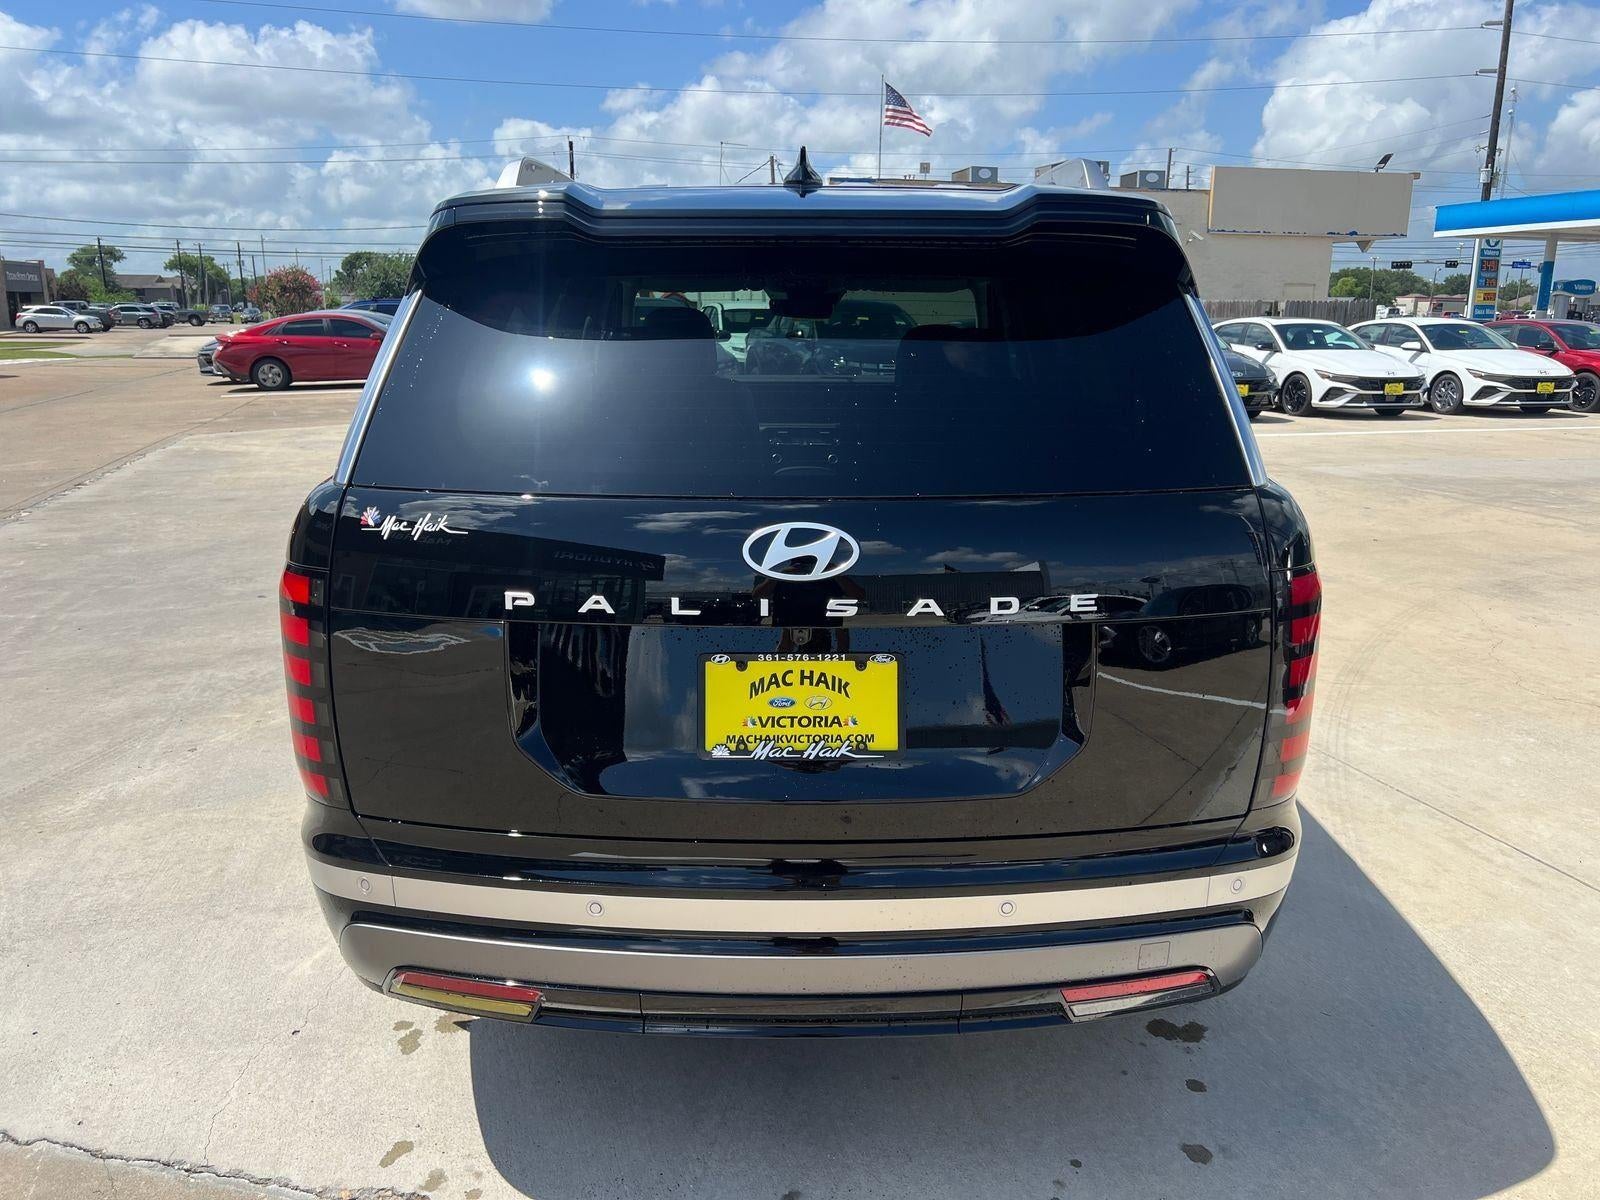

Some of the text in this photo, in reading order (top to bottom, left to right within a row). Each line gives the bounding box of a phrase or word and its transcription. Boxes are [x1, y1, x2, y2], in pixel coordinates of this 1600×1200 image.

[380, 515, 411, 540] Mac
[411, 512, 468, 541] Haik
[504, 591, 1099, 617] PALISADE
[757, 653, 847, 662] 361-576-1221
[749, 669, 851, 700] MAC HAIK
[771, 698, 793, 708] Ford
[758, 715, 843, 728] VICTORIA
[726, 733, 875, 744] MACHAIKVICTORIA.COM
[750, 740, 868, 760] Mac Haik
